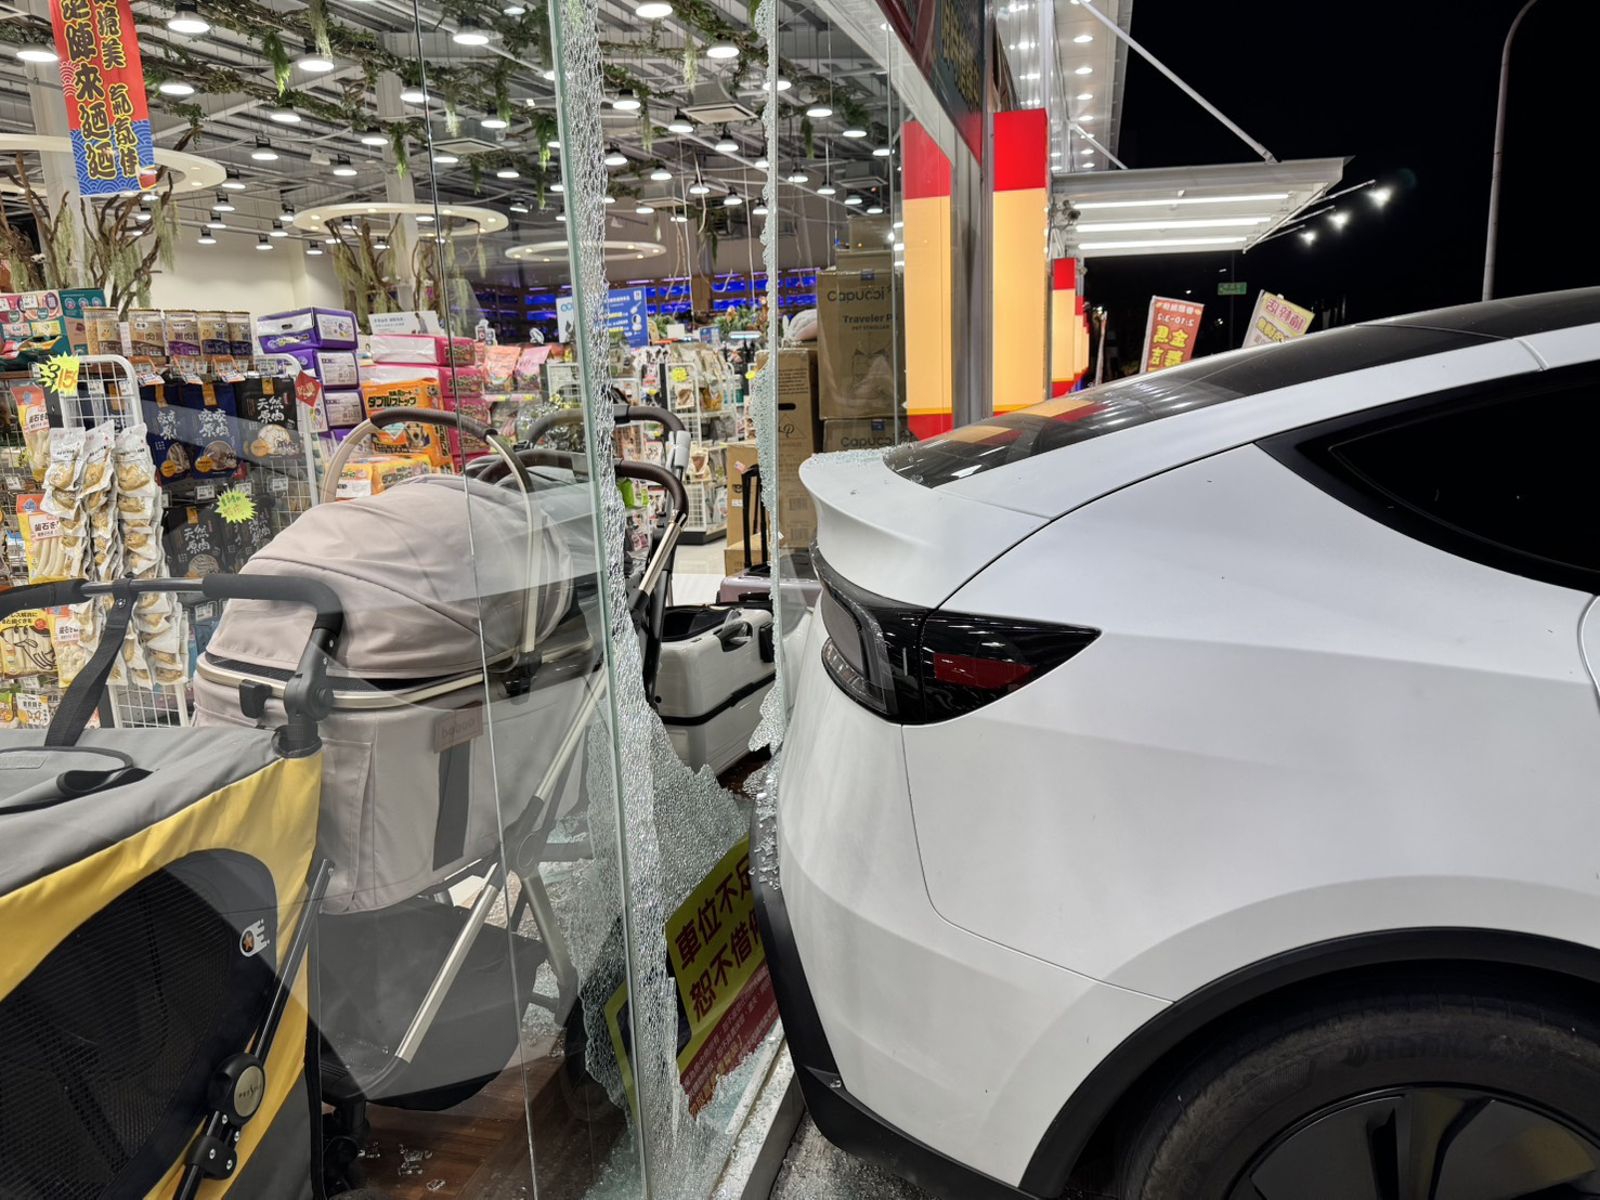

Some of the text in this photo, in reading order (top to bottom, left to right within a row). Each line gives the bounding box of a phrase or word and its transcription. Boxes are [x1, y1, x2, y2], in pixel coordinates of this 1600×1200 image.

[93, 0, 126, 70] 境美
[842, 313, 884, 324] Traveler
[257, 396, 284, 410] 天然
[257, 410, 285, 424] 原肉
[184, 524, 209, 539] 天然
